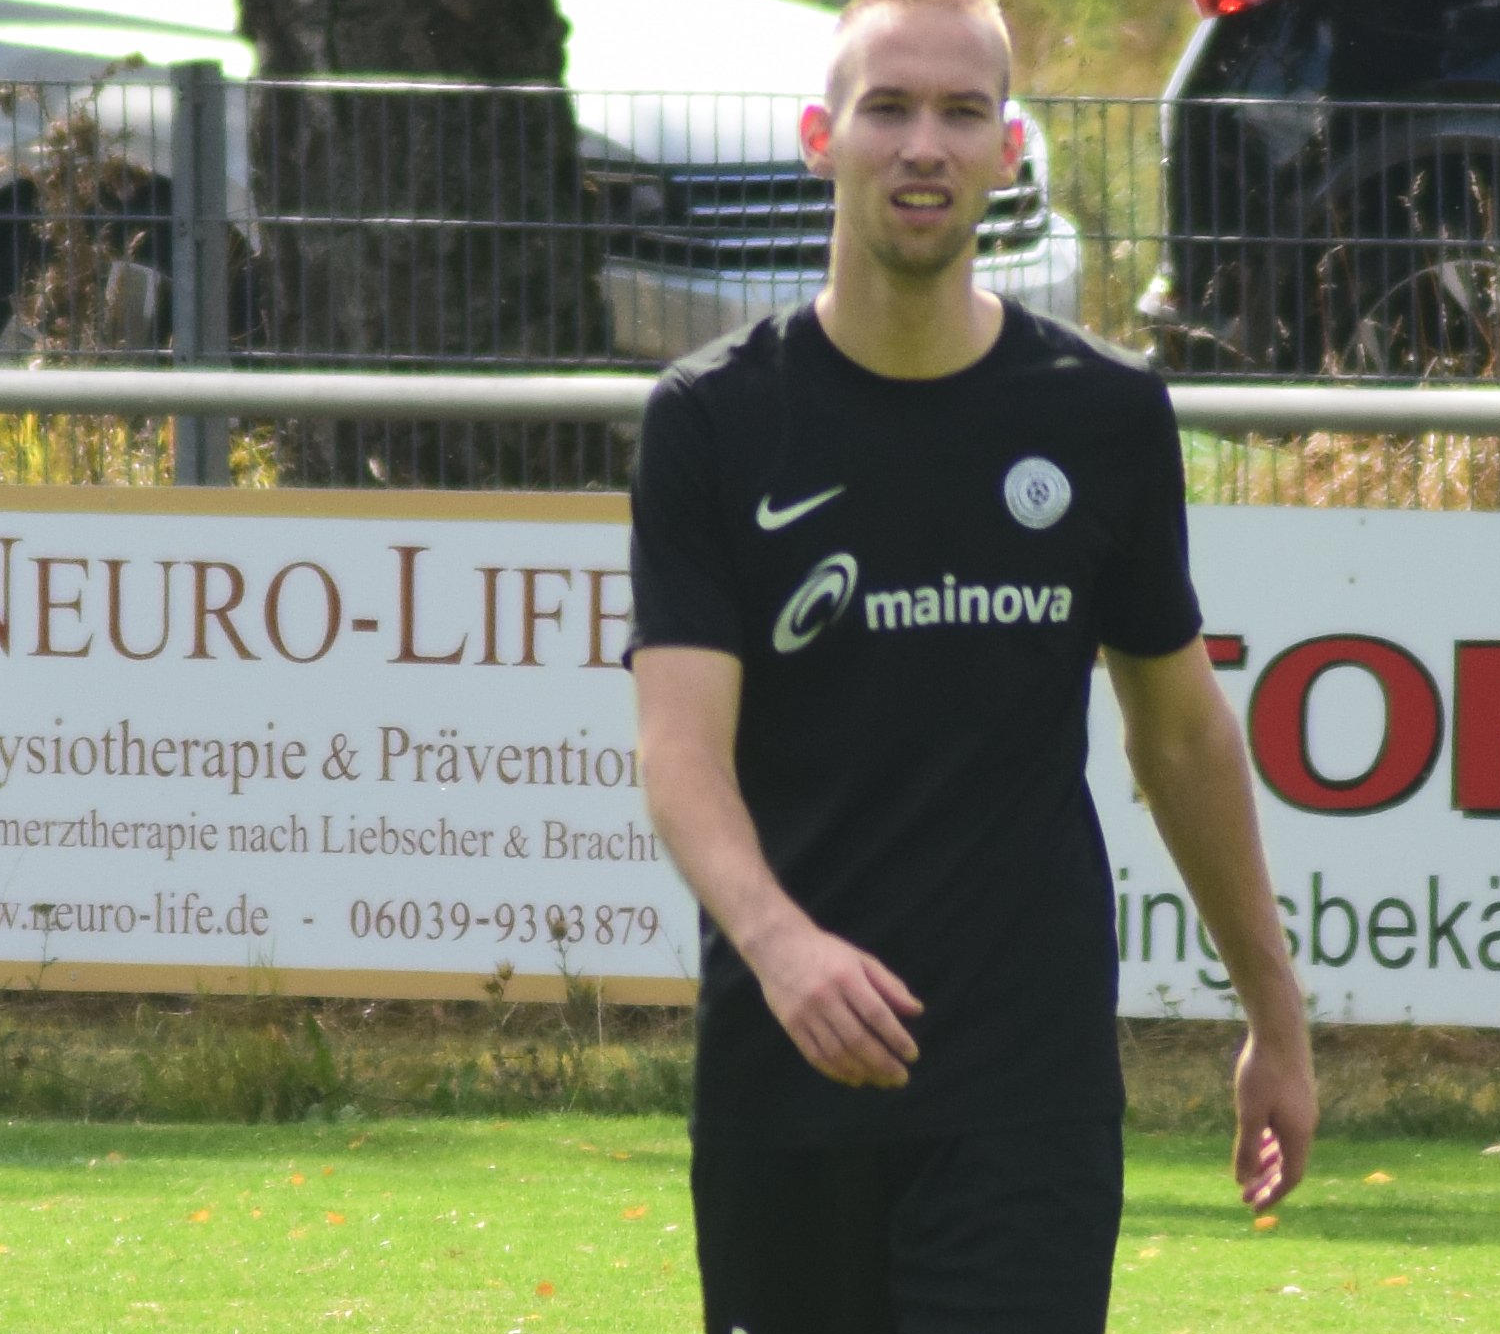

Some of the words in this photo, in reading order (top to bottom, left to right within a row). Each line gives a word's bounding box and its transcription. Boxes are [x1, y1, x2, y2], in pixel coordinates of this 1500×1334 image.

[866, 573, 1073, 631] mainova
[322, 731, 361, 781] &
[228, 815, 309, 854] nach
[321, 815, 492, 858] Liebscher
[503, 825, 530, 860] &
[542, 819, 661, 864] Bracht
